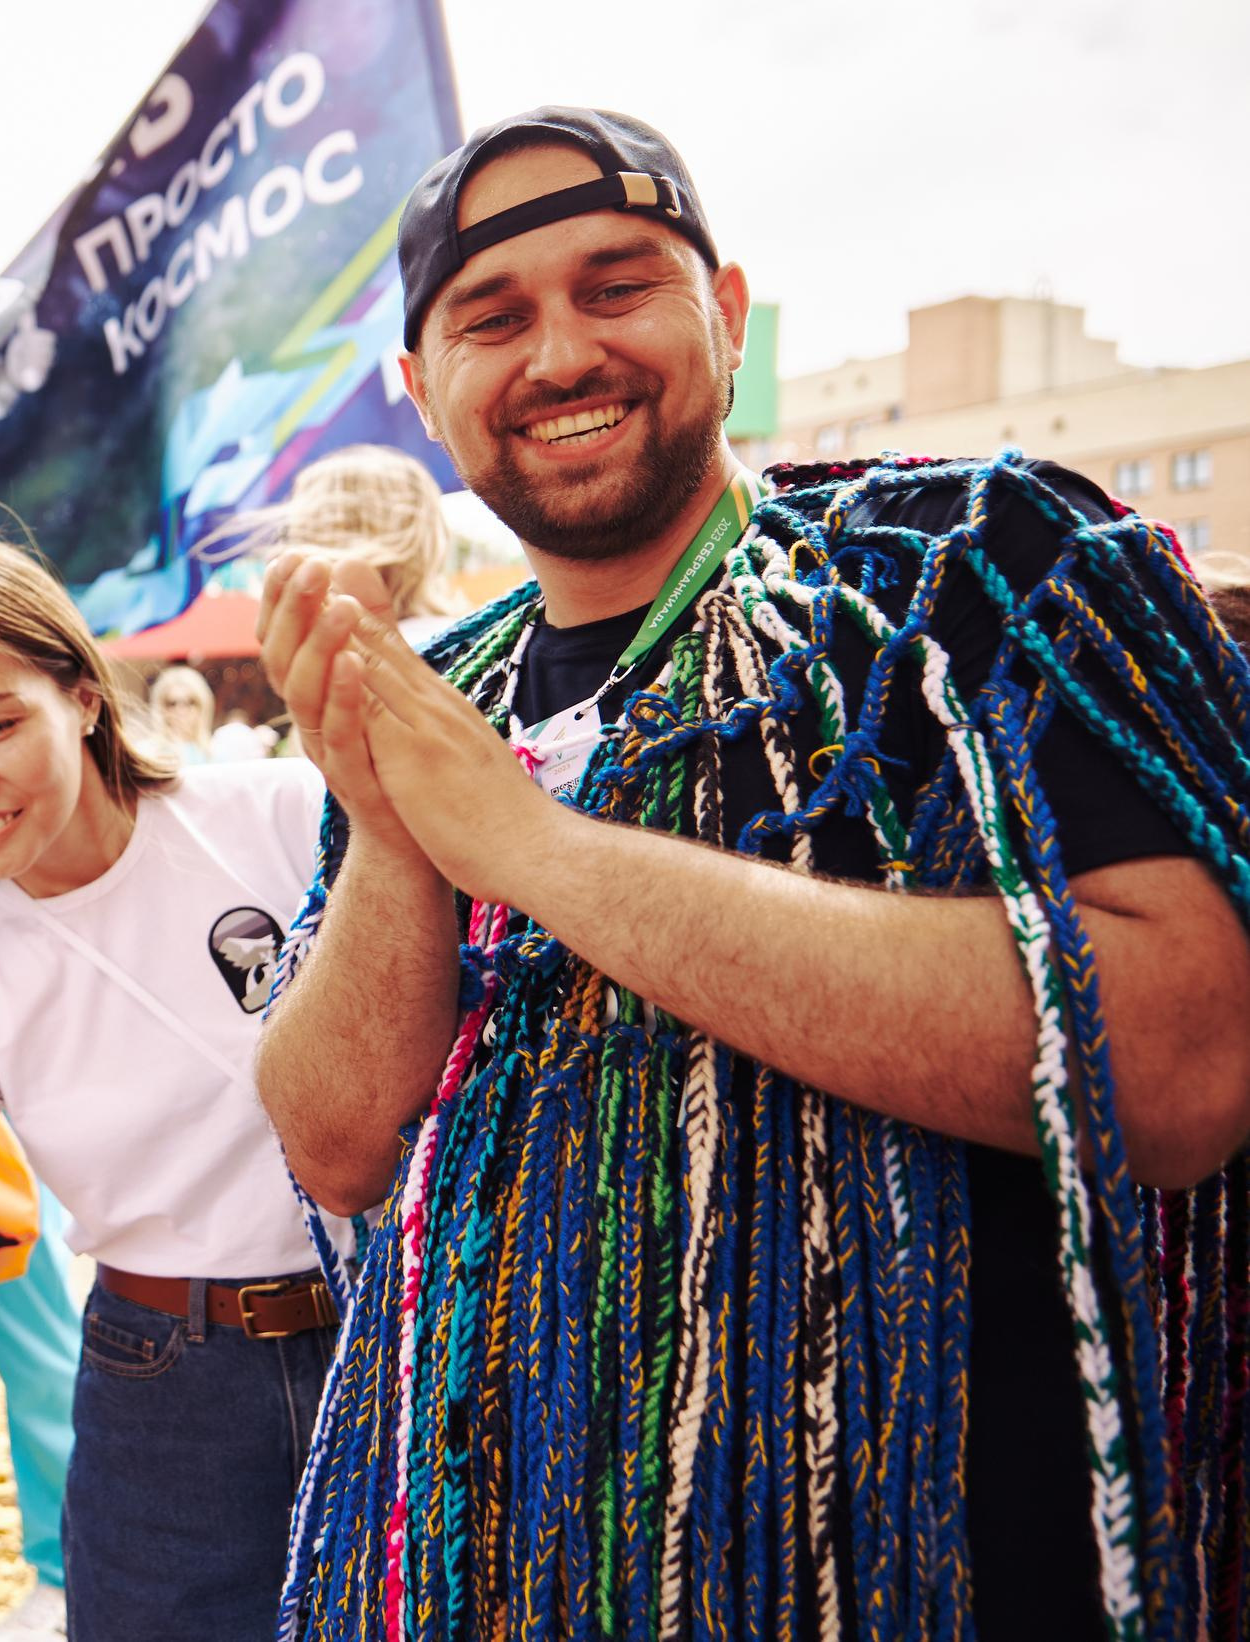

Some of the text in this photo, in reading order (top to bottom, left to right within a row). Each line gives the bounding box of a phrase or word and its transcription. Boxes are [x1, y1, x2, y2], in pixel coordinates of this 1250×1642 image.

[74, 52, 325, 292] ПРОСТО
[104, 130, 363, 374] КОСМОС
[649, 518, 731, 628] 2023 СБЕРБАНКИАДА
